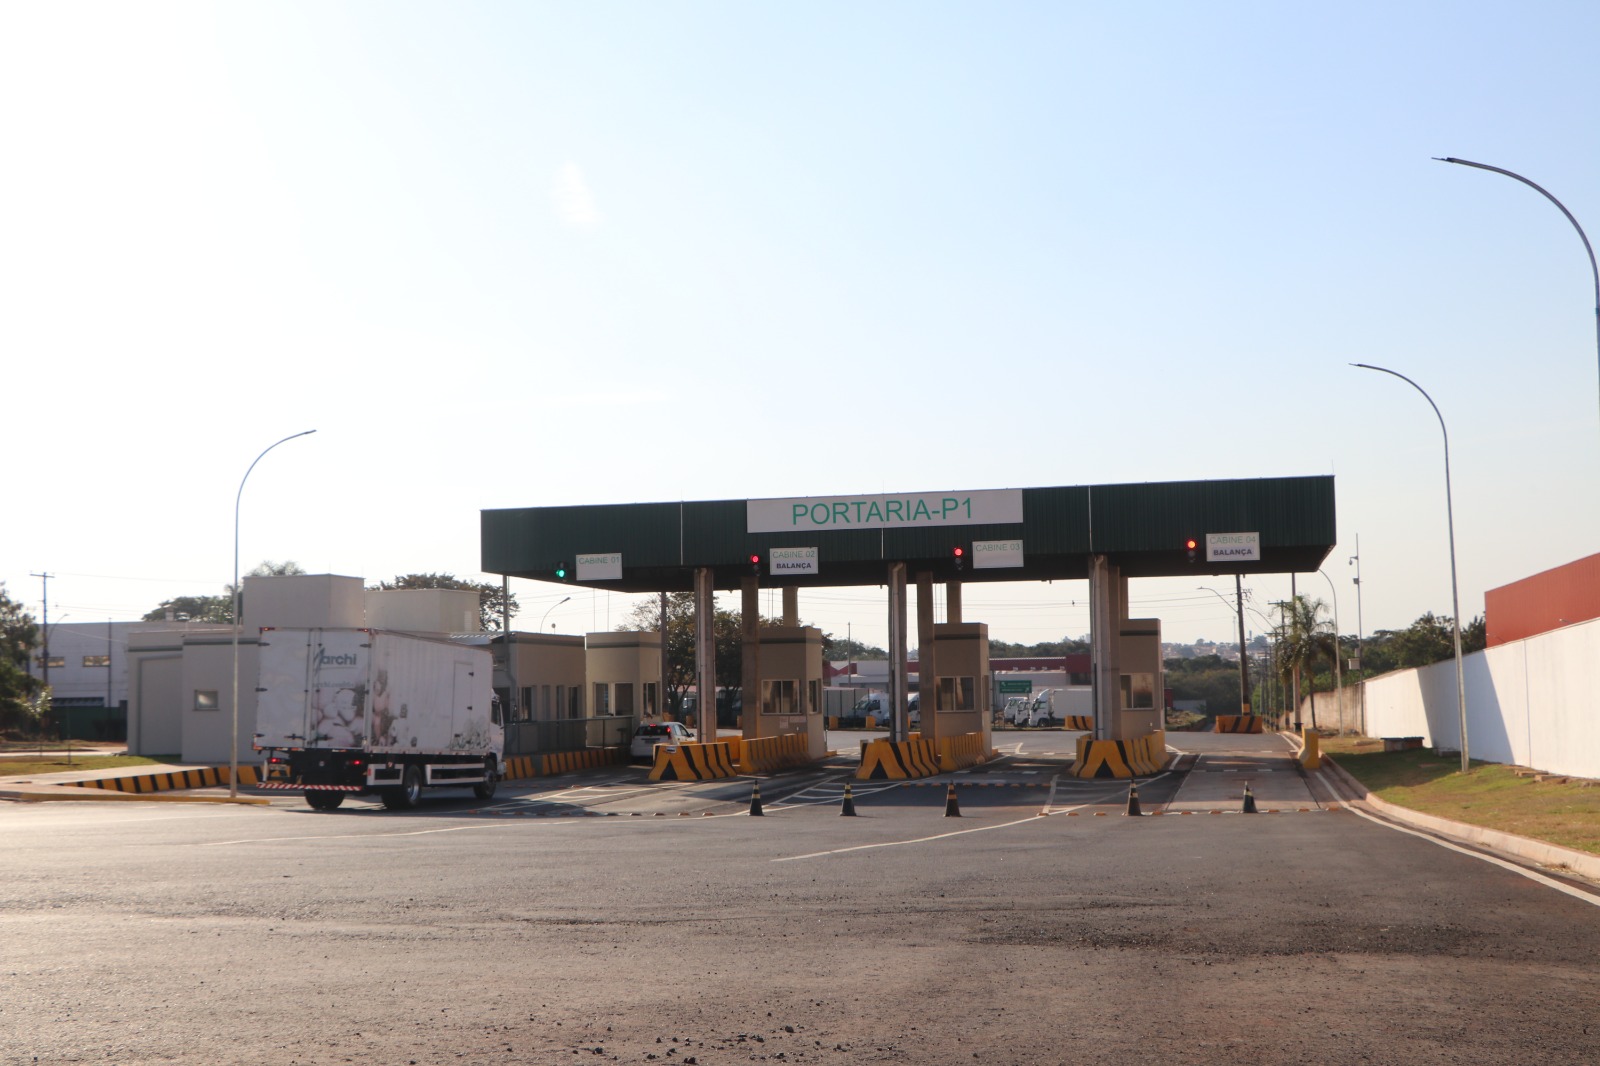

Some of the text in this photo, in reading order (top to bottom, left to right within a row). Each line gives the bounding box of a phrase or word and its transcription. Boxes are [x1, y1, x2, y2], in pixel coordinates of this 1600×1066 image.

[793, 497, 971, 525] PORTARIA-P1
[1210, 535, 1256, 544] CABINE 04
[976, 543, 1020, 552] CABINE 03
[1213, 548, 1252, 556] BALANÇA
[806, 550, 815, 558] 02
[579, 556, 619, 565] CABINE 01
[776, 562, 812, 570] BALANÇA
